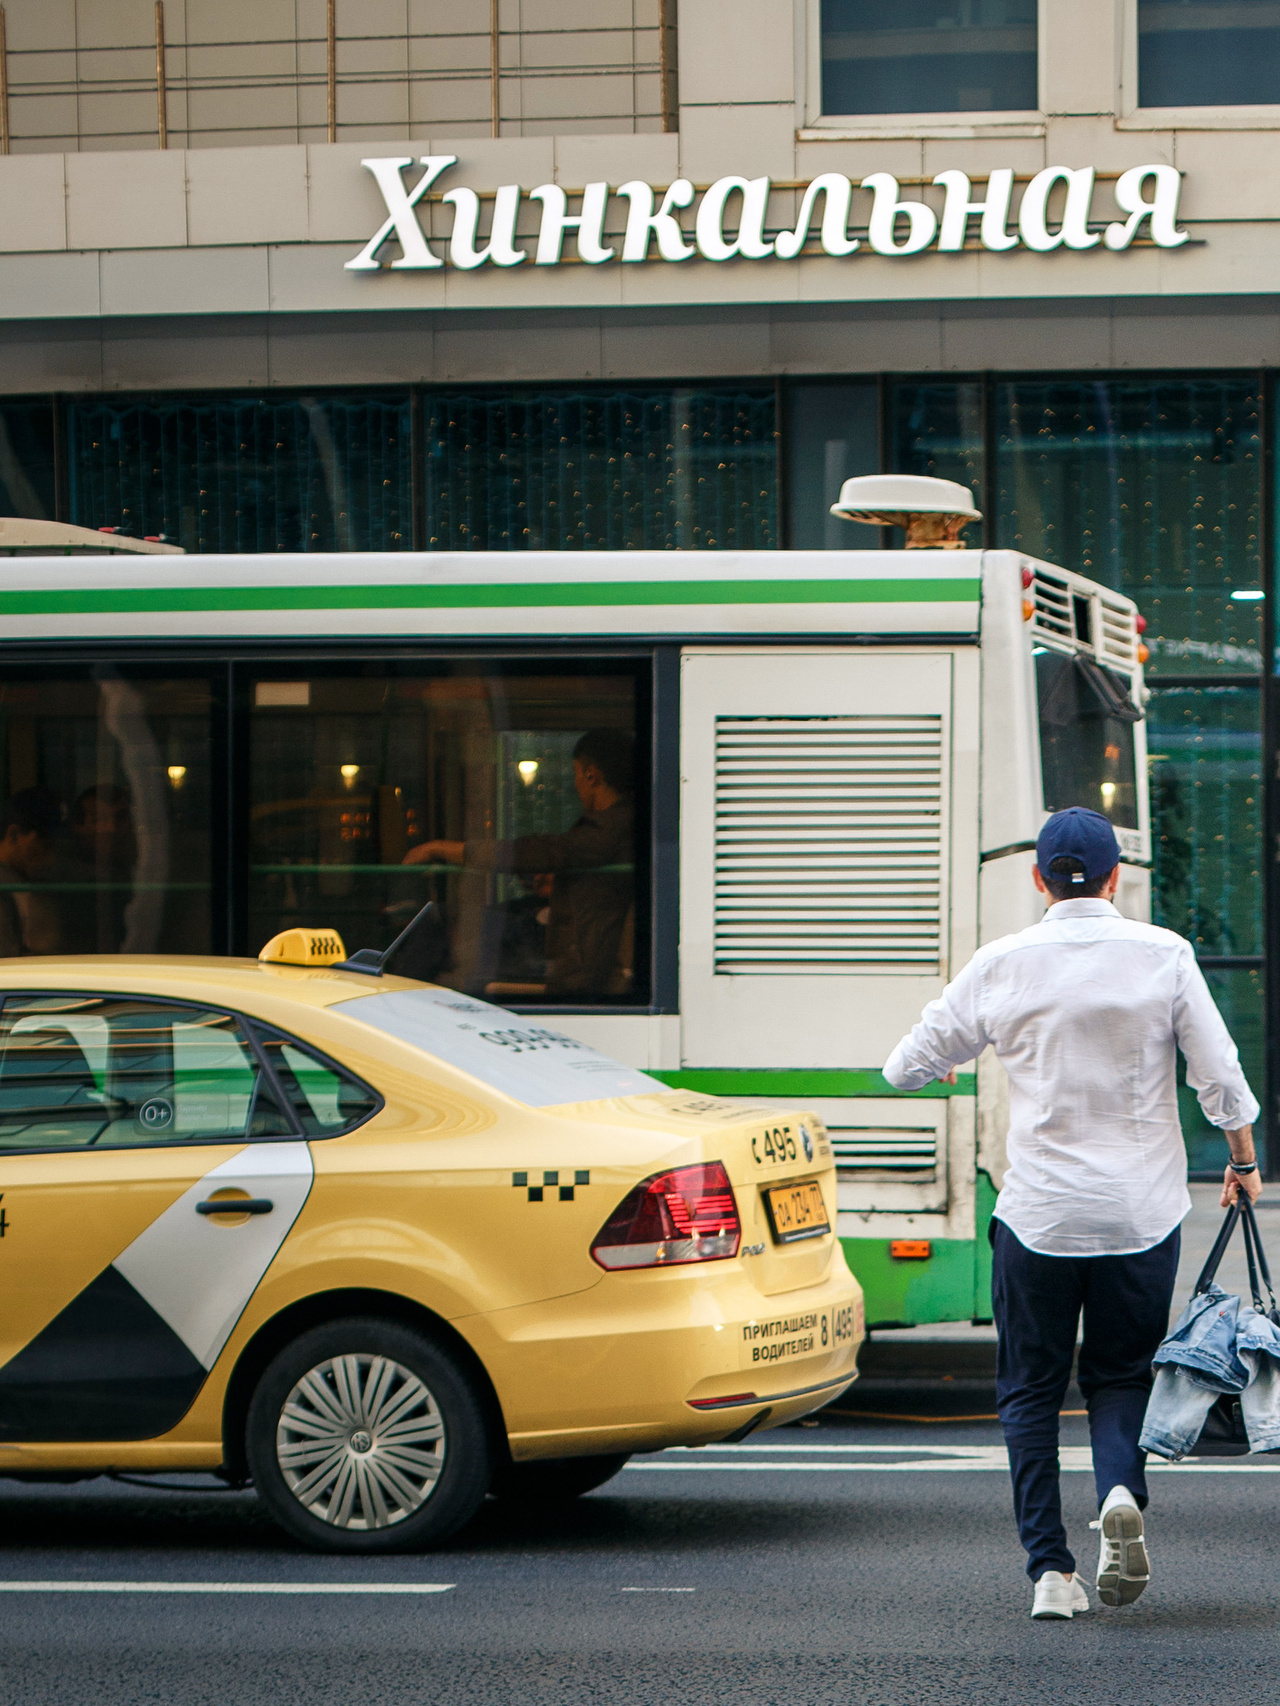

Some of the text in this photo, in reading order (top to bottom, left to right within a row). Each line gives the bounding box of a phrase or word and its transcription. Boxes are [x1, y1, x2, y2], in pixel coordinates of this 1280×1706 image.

[345, 156, 1190, 271] Хинкальная
[145, 1106, 169, 1122] 0+
[764, 1127, 797, 1163] 495
[743, 1313, 817, 1340] ПРИГЛАШАЕМ
[821, 1314, 828, 1346] 8
[752, 1333, 813, 1362] ВОДИТЕЛЕЙ
